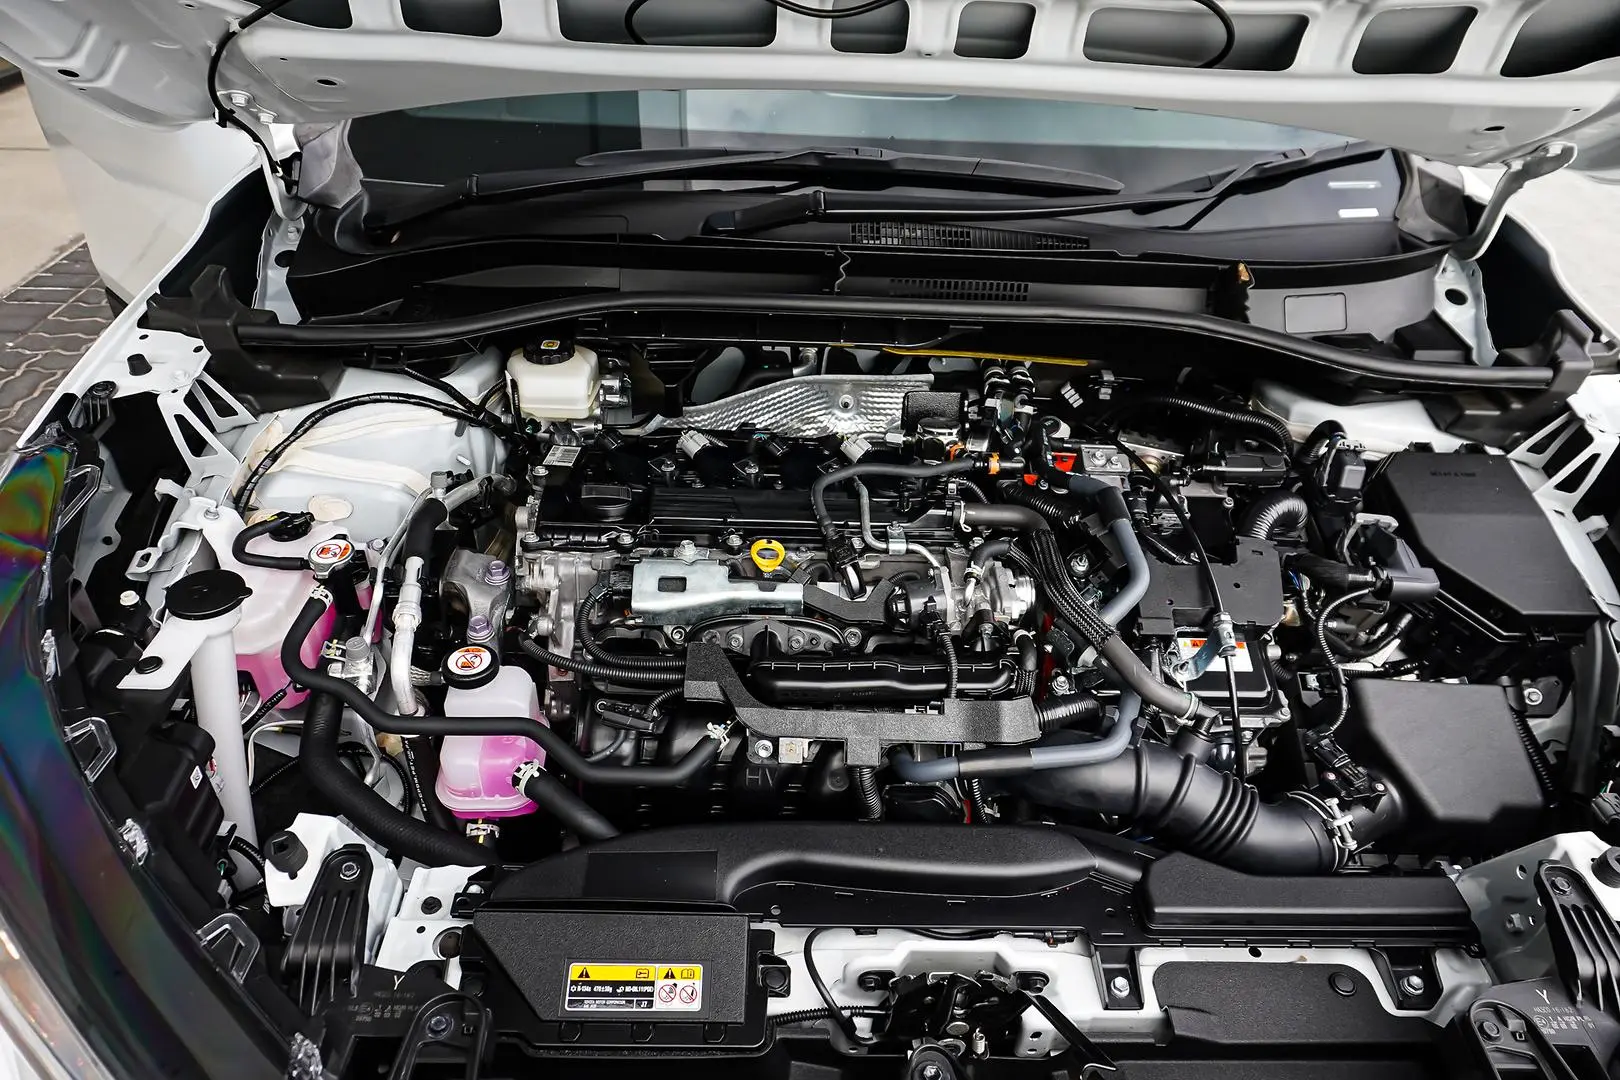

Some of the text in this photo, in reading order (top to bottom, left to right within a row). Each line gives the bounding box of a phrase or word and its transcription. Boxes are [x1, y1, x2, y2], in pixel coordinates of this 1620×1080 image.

[745, 767, 778, 787] HV
[393, 974, 406, 990] Y
[1535, 988, 1551, 1005] Y
